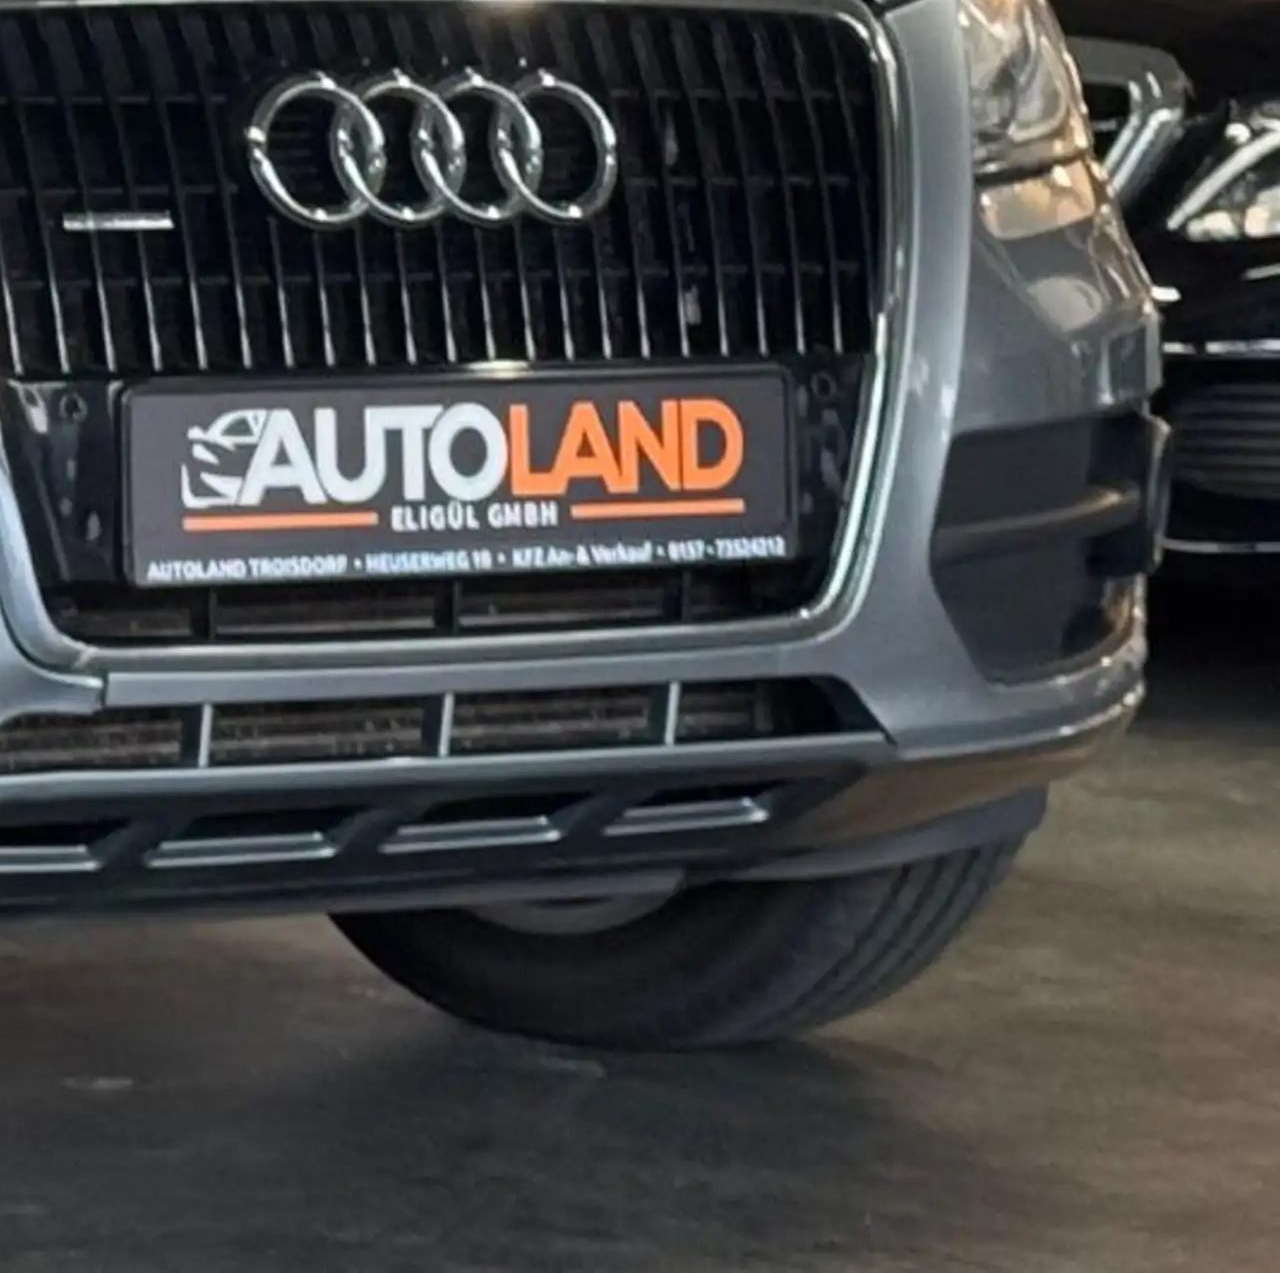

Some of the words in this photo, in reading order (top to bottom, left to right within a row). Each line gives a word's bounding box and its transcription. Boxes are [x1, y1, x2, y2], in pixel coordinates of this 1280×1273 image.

[239, 400, 744, 504] AUTOLAND
[391, 500, 480, 533] ELIGÜL
[487, 500, 559, 529] GMBH
[146, 557, 247, 583] AUTOLAND
[248, 553, 348, 577] TROISDORF
